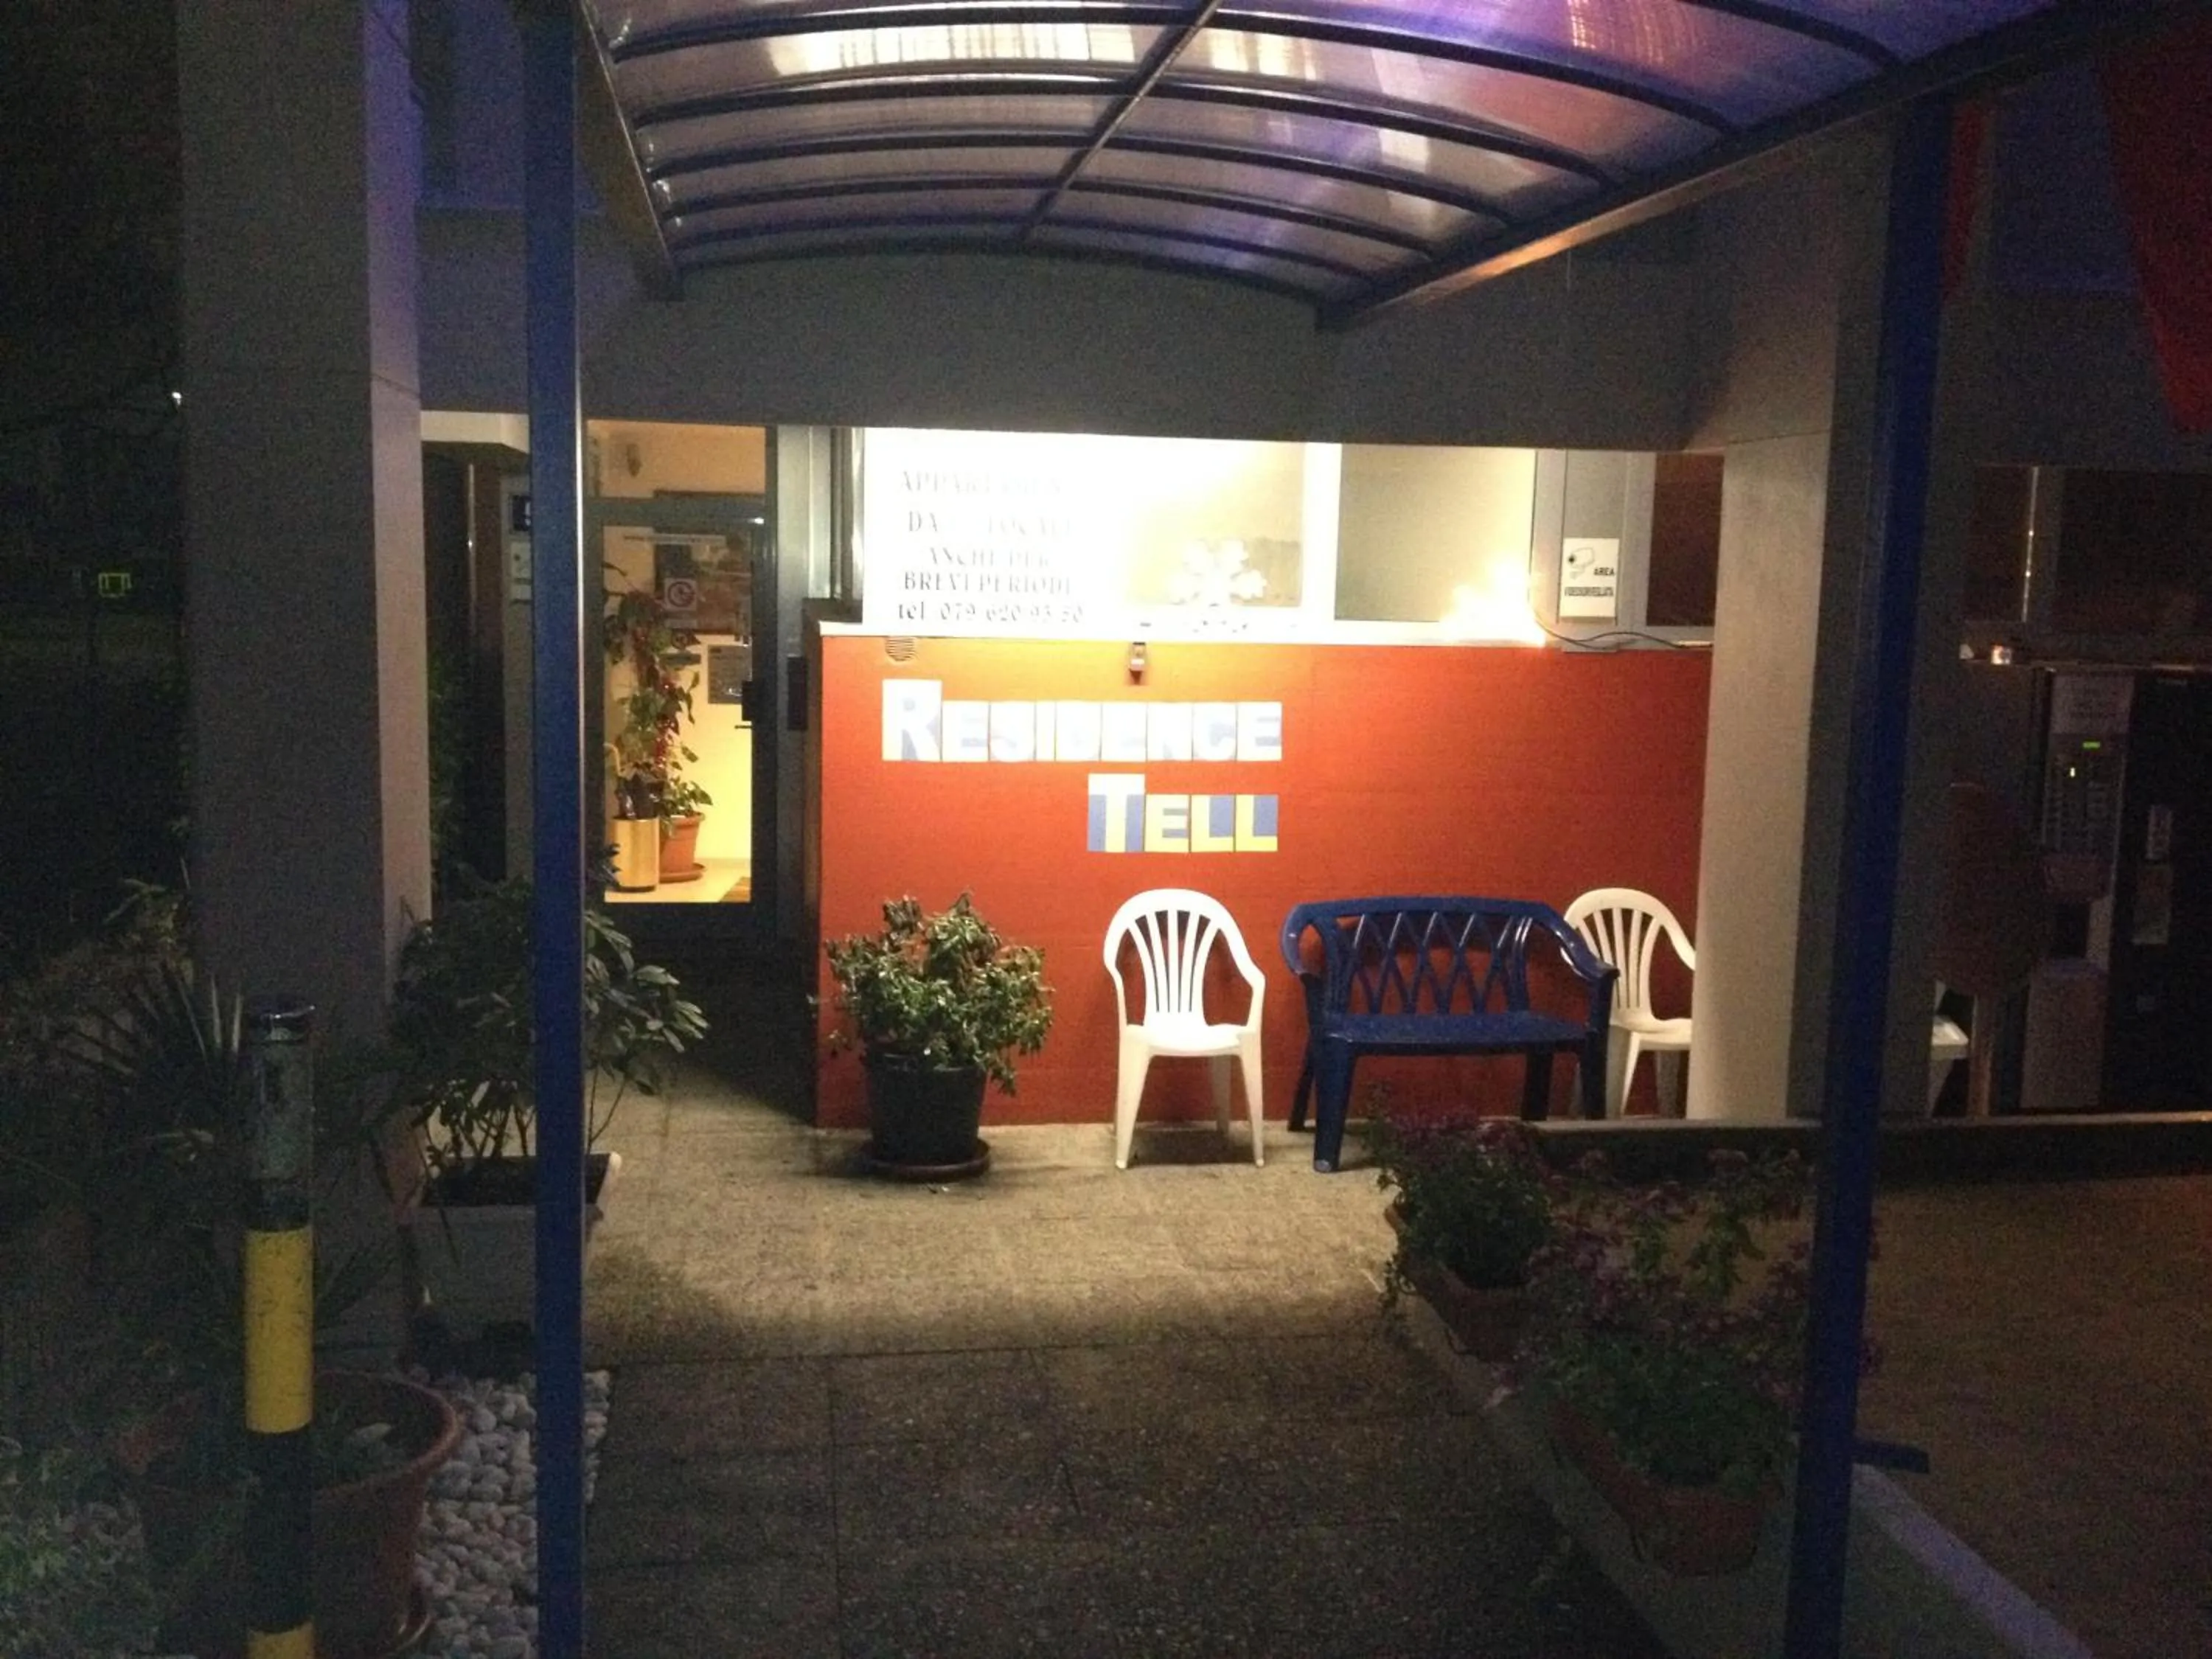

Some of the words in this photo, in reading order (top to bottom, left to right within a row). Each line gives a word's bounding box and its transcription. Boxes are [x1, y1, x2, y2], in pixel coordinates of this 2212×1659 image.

[907, 509, 939, 533] DA
[902, 570, 970, 592] BREVI
[1088, 773, 1279, 852] TELL
